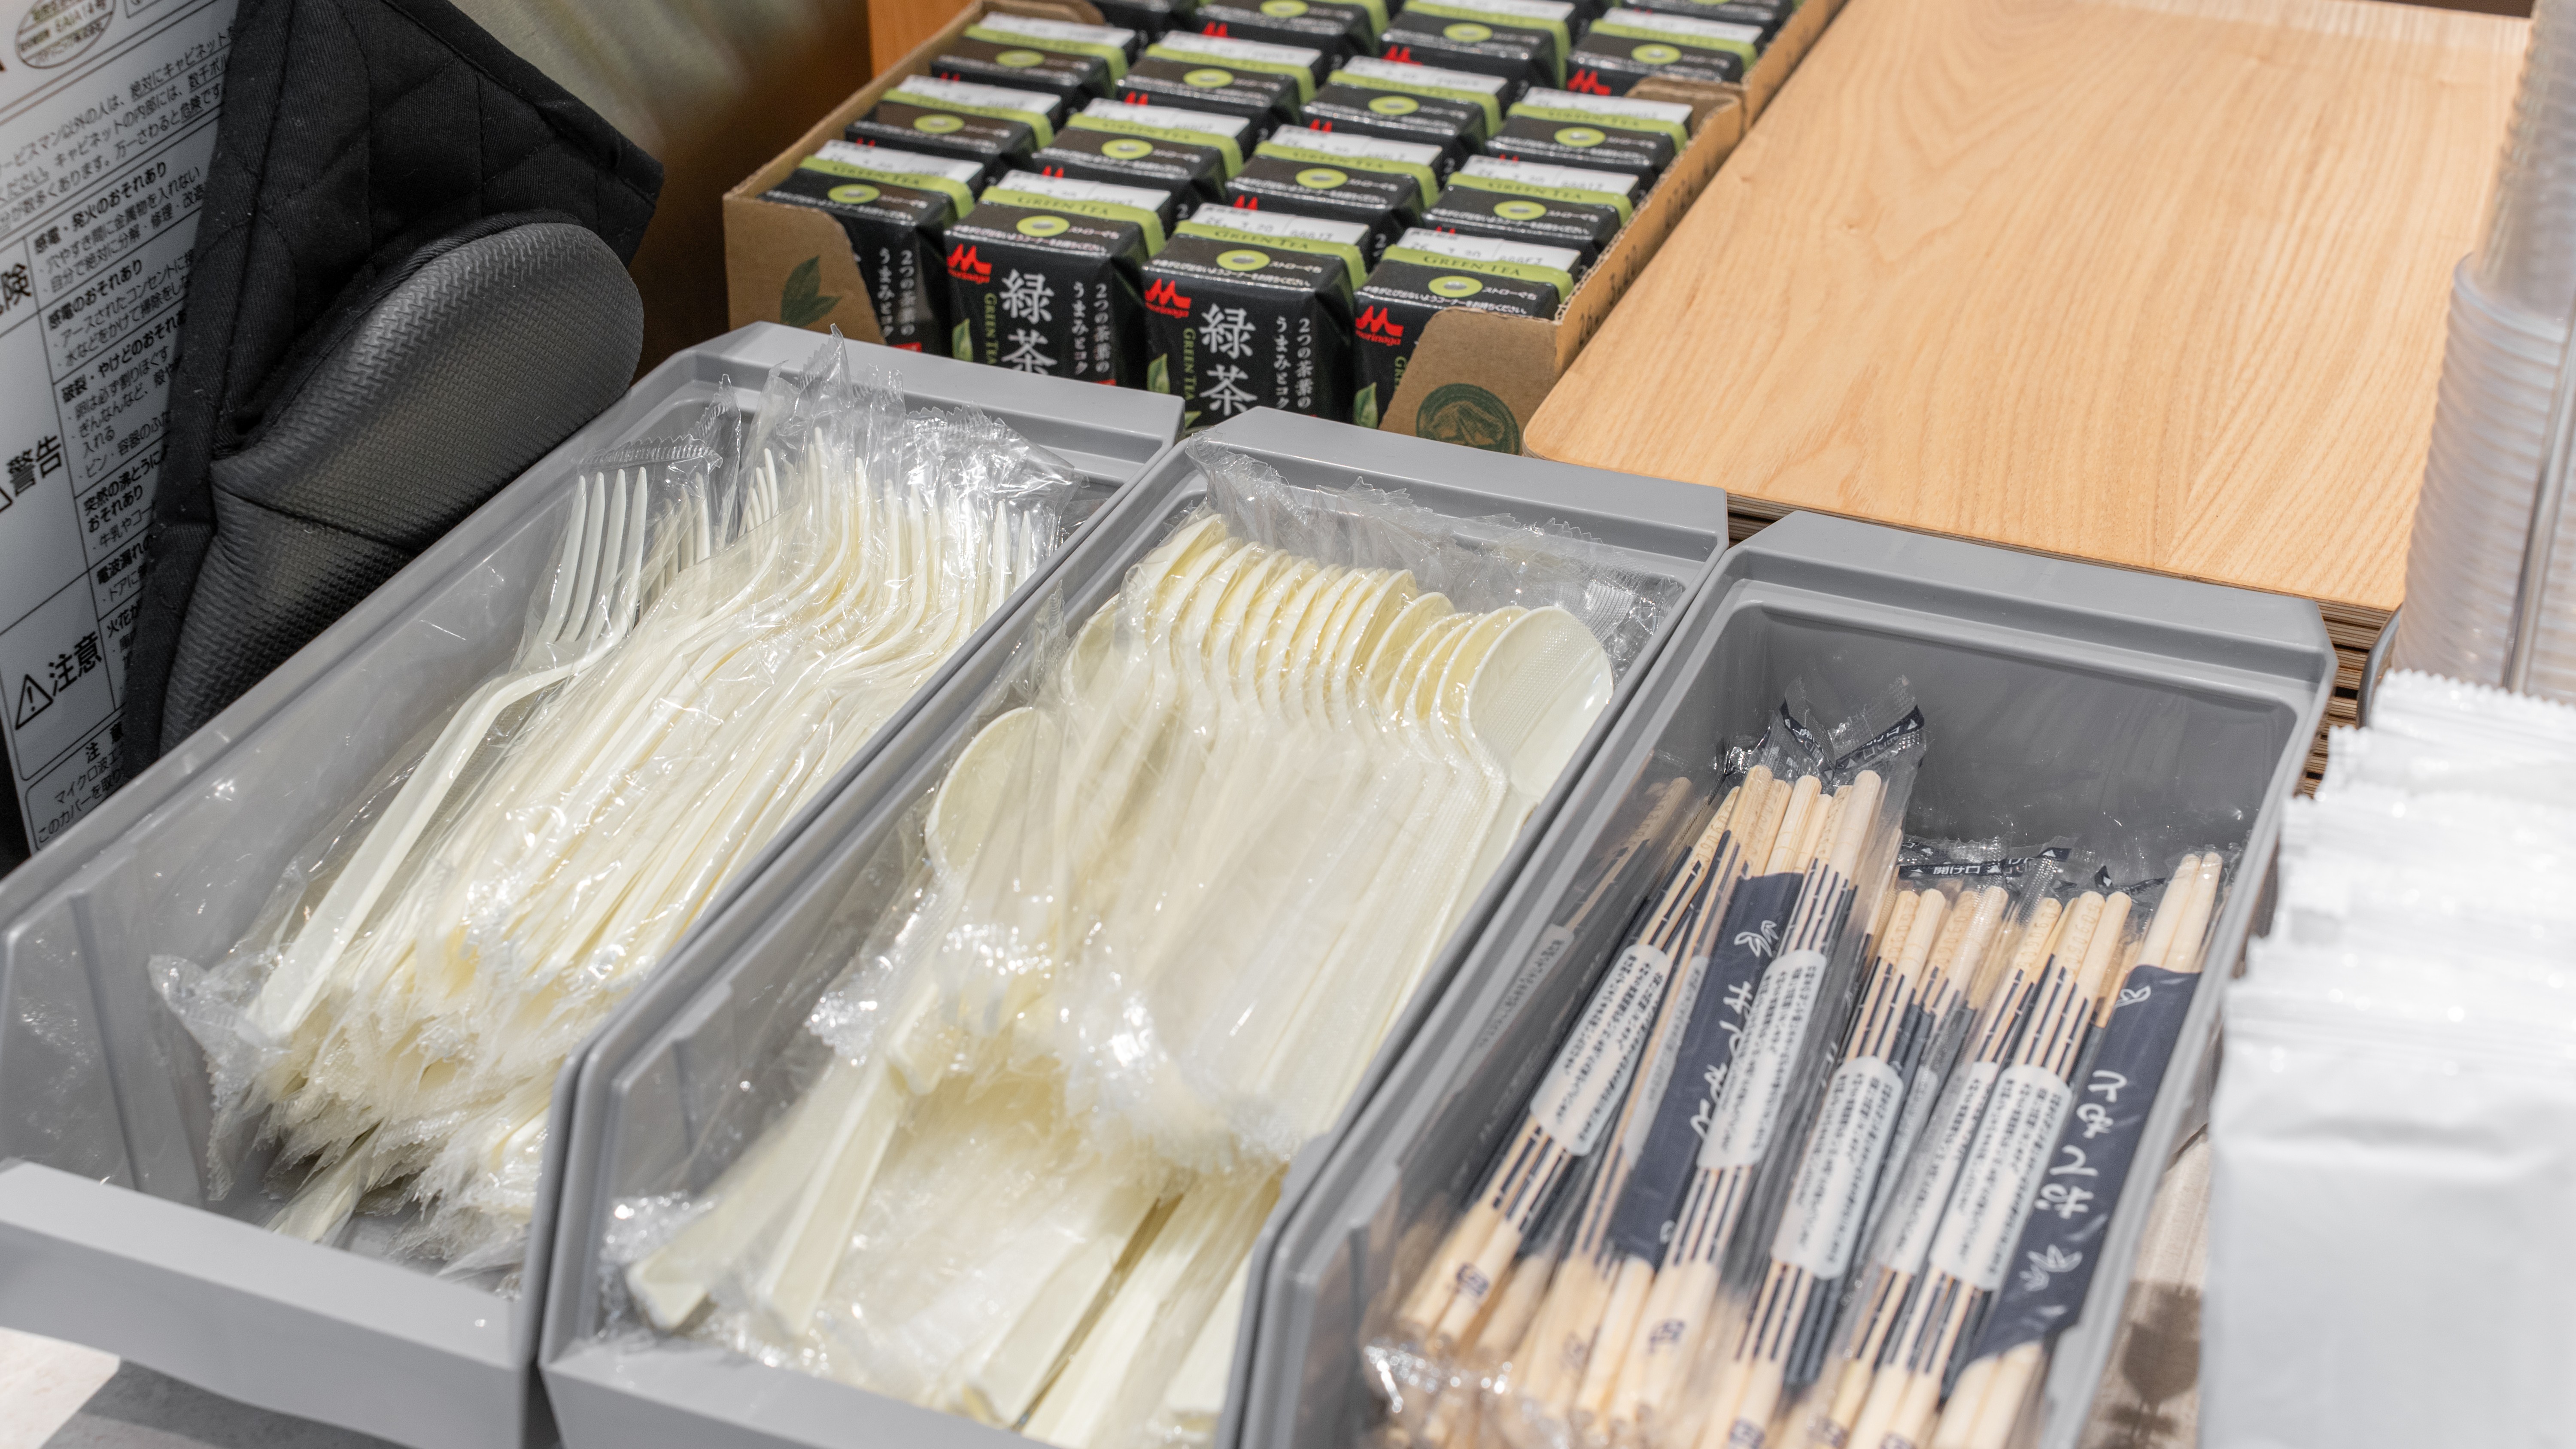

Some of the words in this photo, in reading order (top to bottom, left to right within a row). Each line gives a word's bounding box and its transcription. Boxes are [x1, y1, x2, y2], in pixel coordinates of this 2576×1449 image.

[1424, 255, 1483, 270] GREEN
[1490, 264, 1521, 276] TEA
[1199, 303, 1258, 417] 緑茶
[7, 435, 62, 497] 警告
[83, 425, 115, 459] 入れる
[88, 484, 143, 533] おそれあり
[49, 630, 102, 698] 注意
[1933, 865, 1981, 875] 開け口
[2035, 1069, 2127, 1219] おてもと
